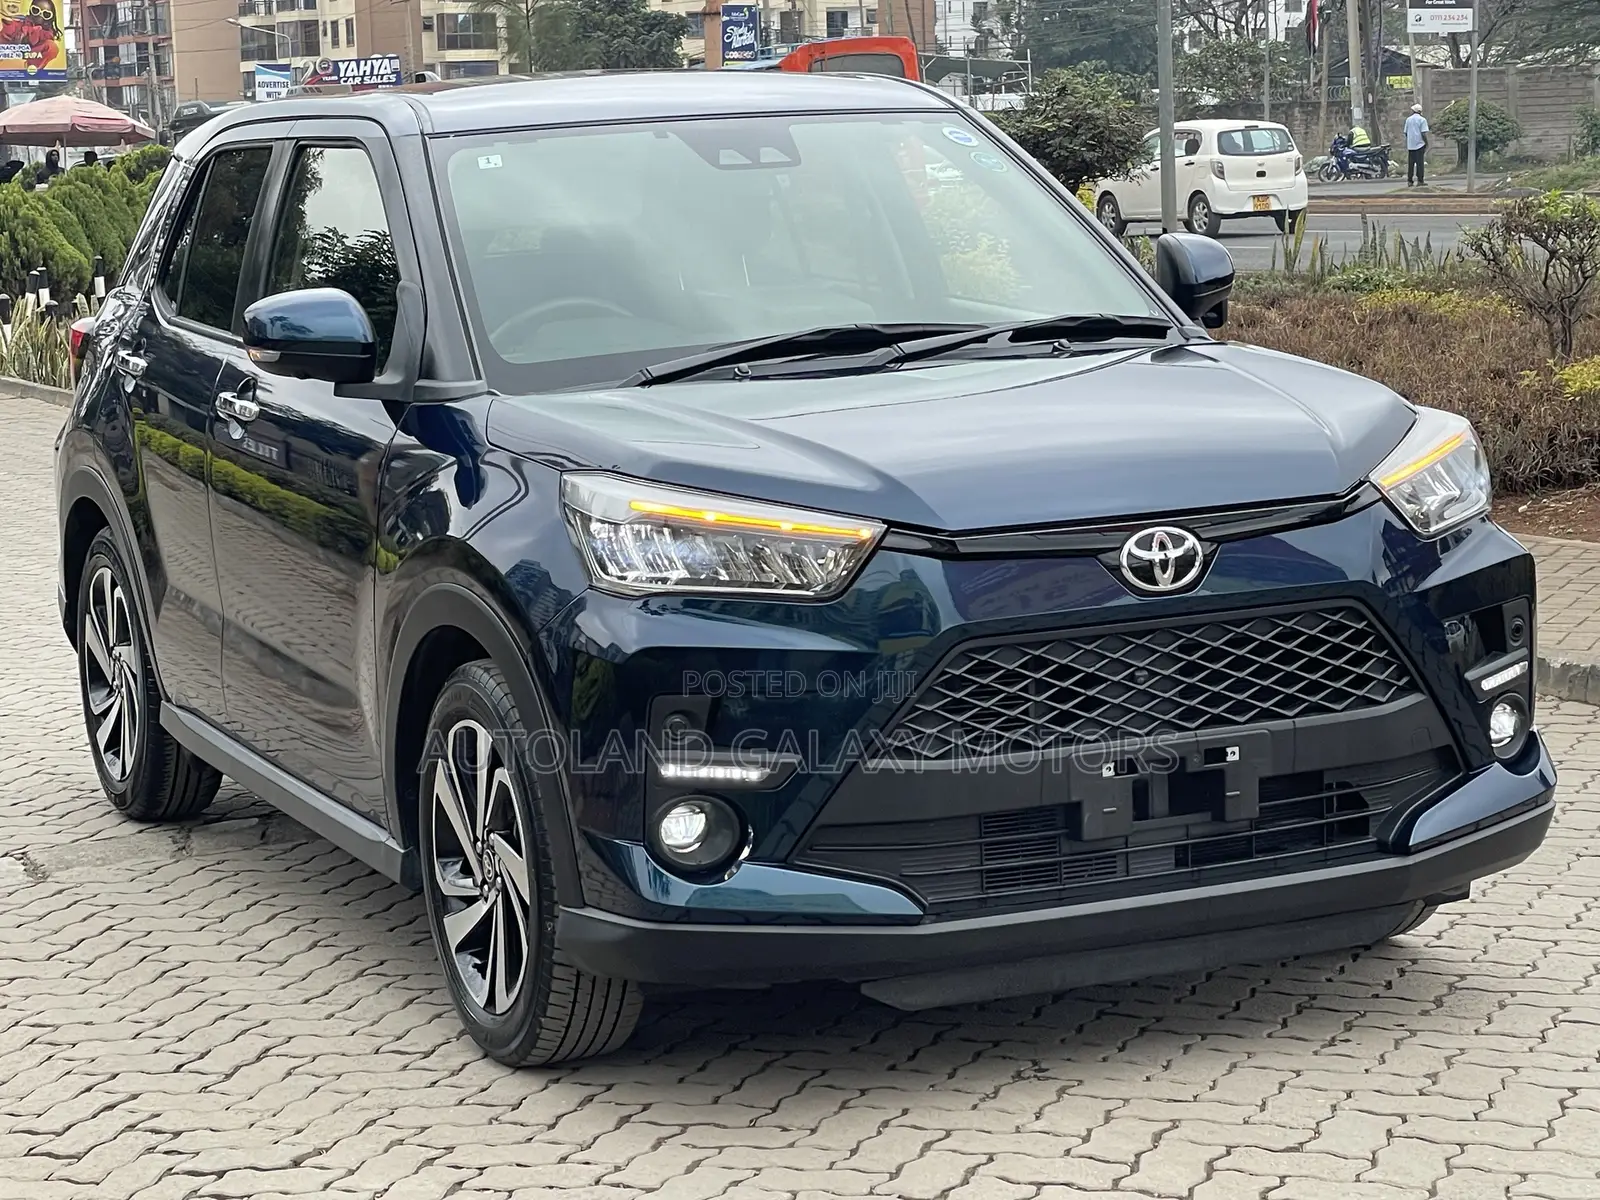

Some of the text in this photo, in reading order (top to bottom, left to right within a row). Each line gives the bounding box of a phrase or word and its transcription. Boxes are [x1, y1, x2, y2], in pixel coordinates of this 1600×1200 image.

[337, 58, 391, 77] YAHYA
[340, 74, 396, 85] CAR SALES
